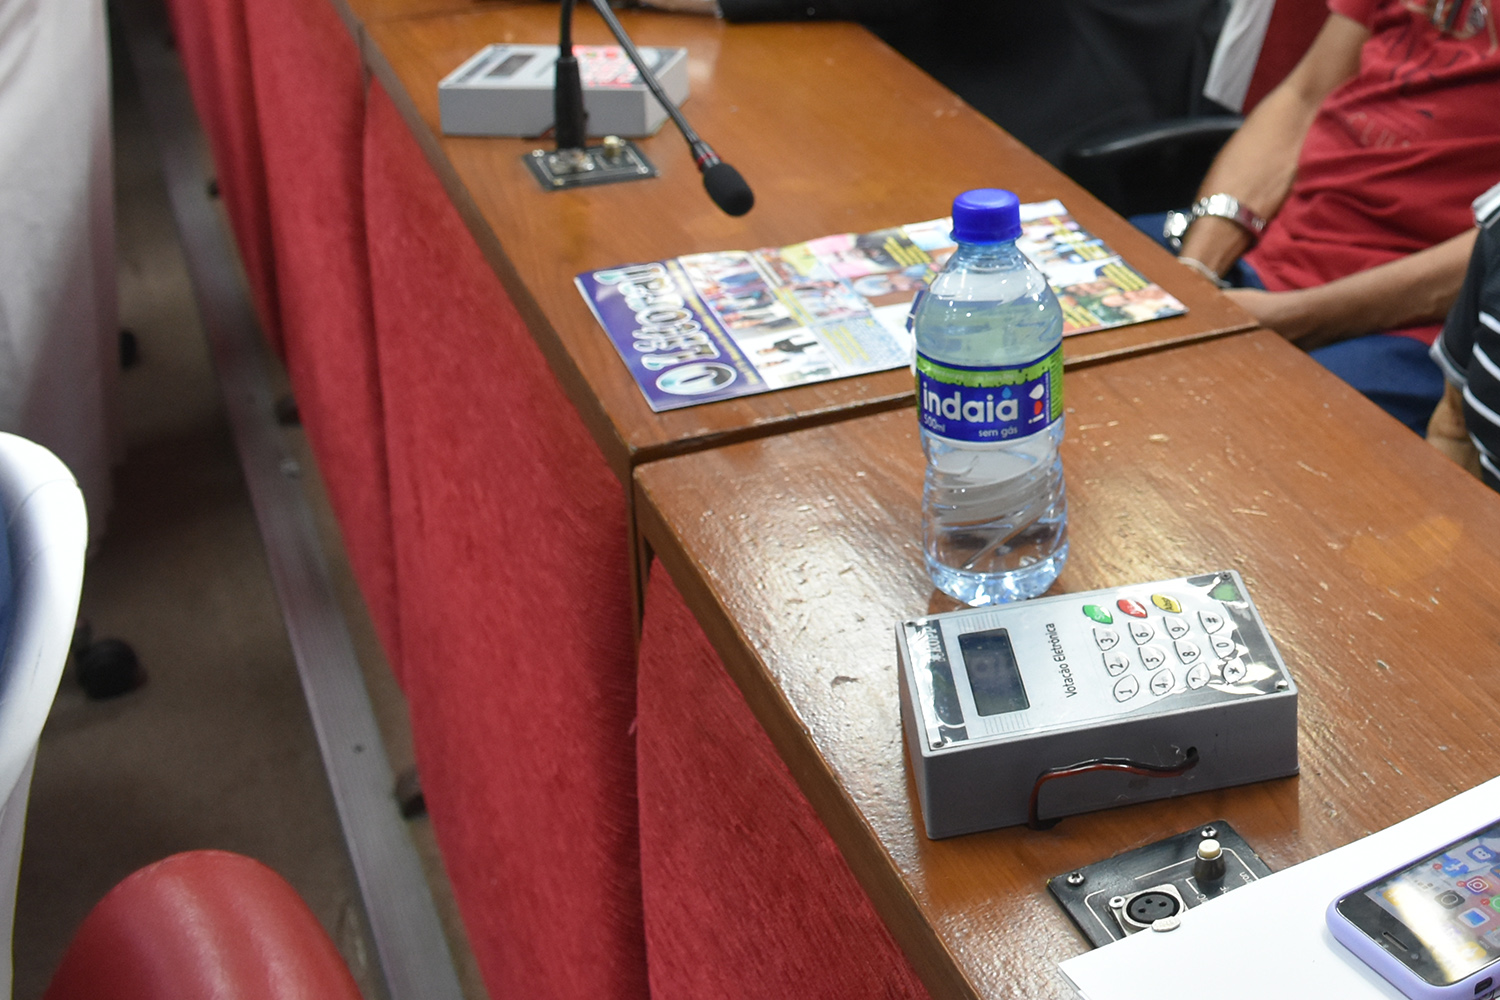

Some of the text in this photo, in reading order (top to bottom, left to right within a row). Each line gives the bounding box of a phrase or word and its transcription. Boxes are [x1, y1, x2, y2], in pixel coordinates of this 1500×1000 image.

[924, 414, 946, 433] 500ml
[978, 426, 1018, 438] sem gás
[1044, 622, 1078, 698] Votação Eletrônica
